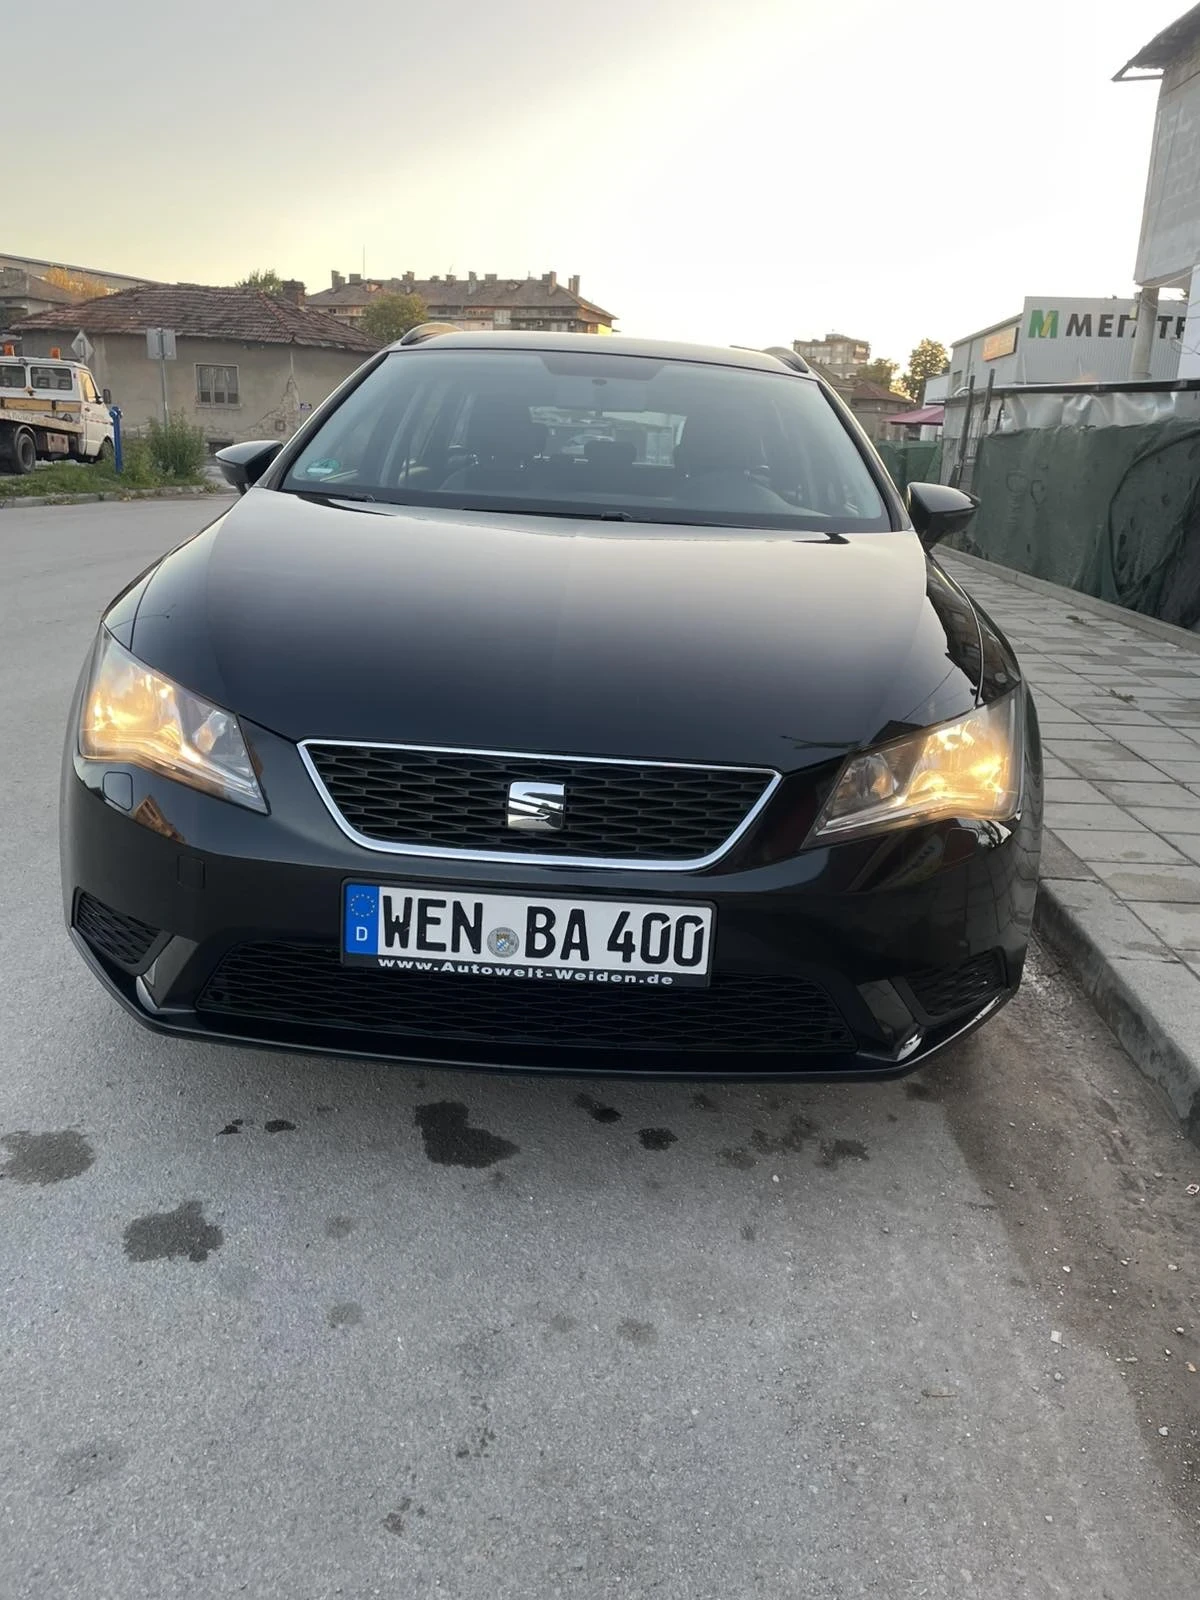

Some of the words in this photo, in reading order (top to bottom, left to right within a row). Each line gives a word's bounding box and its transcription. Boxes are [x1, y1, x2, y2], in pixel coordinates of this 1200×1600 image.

[356, 926, 368, 941] D
[382, 895, 483, 955] WEN
[524, 905, 590, 962] BA
[606, 911, 705, 967] 400
[378, 958, 674, 986] www.Autowelt-Weiden.de
